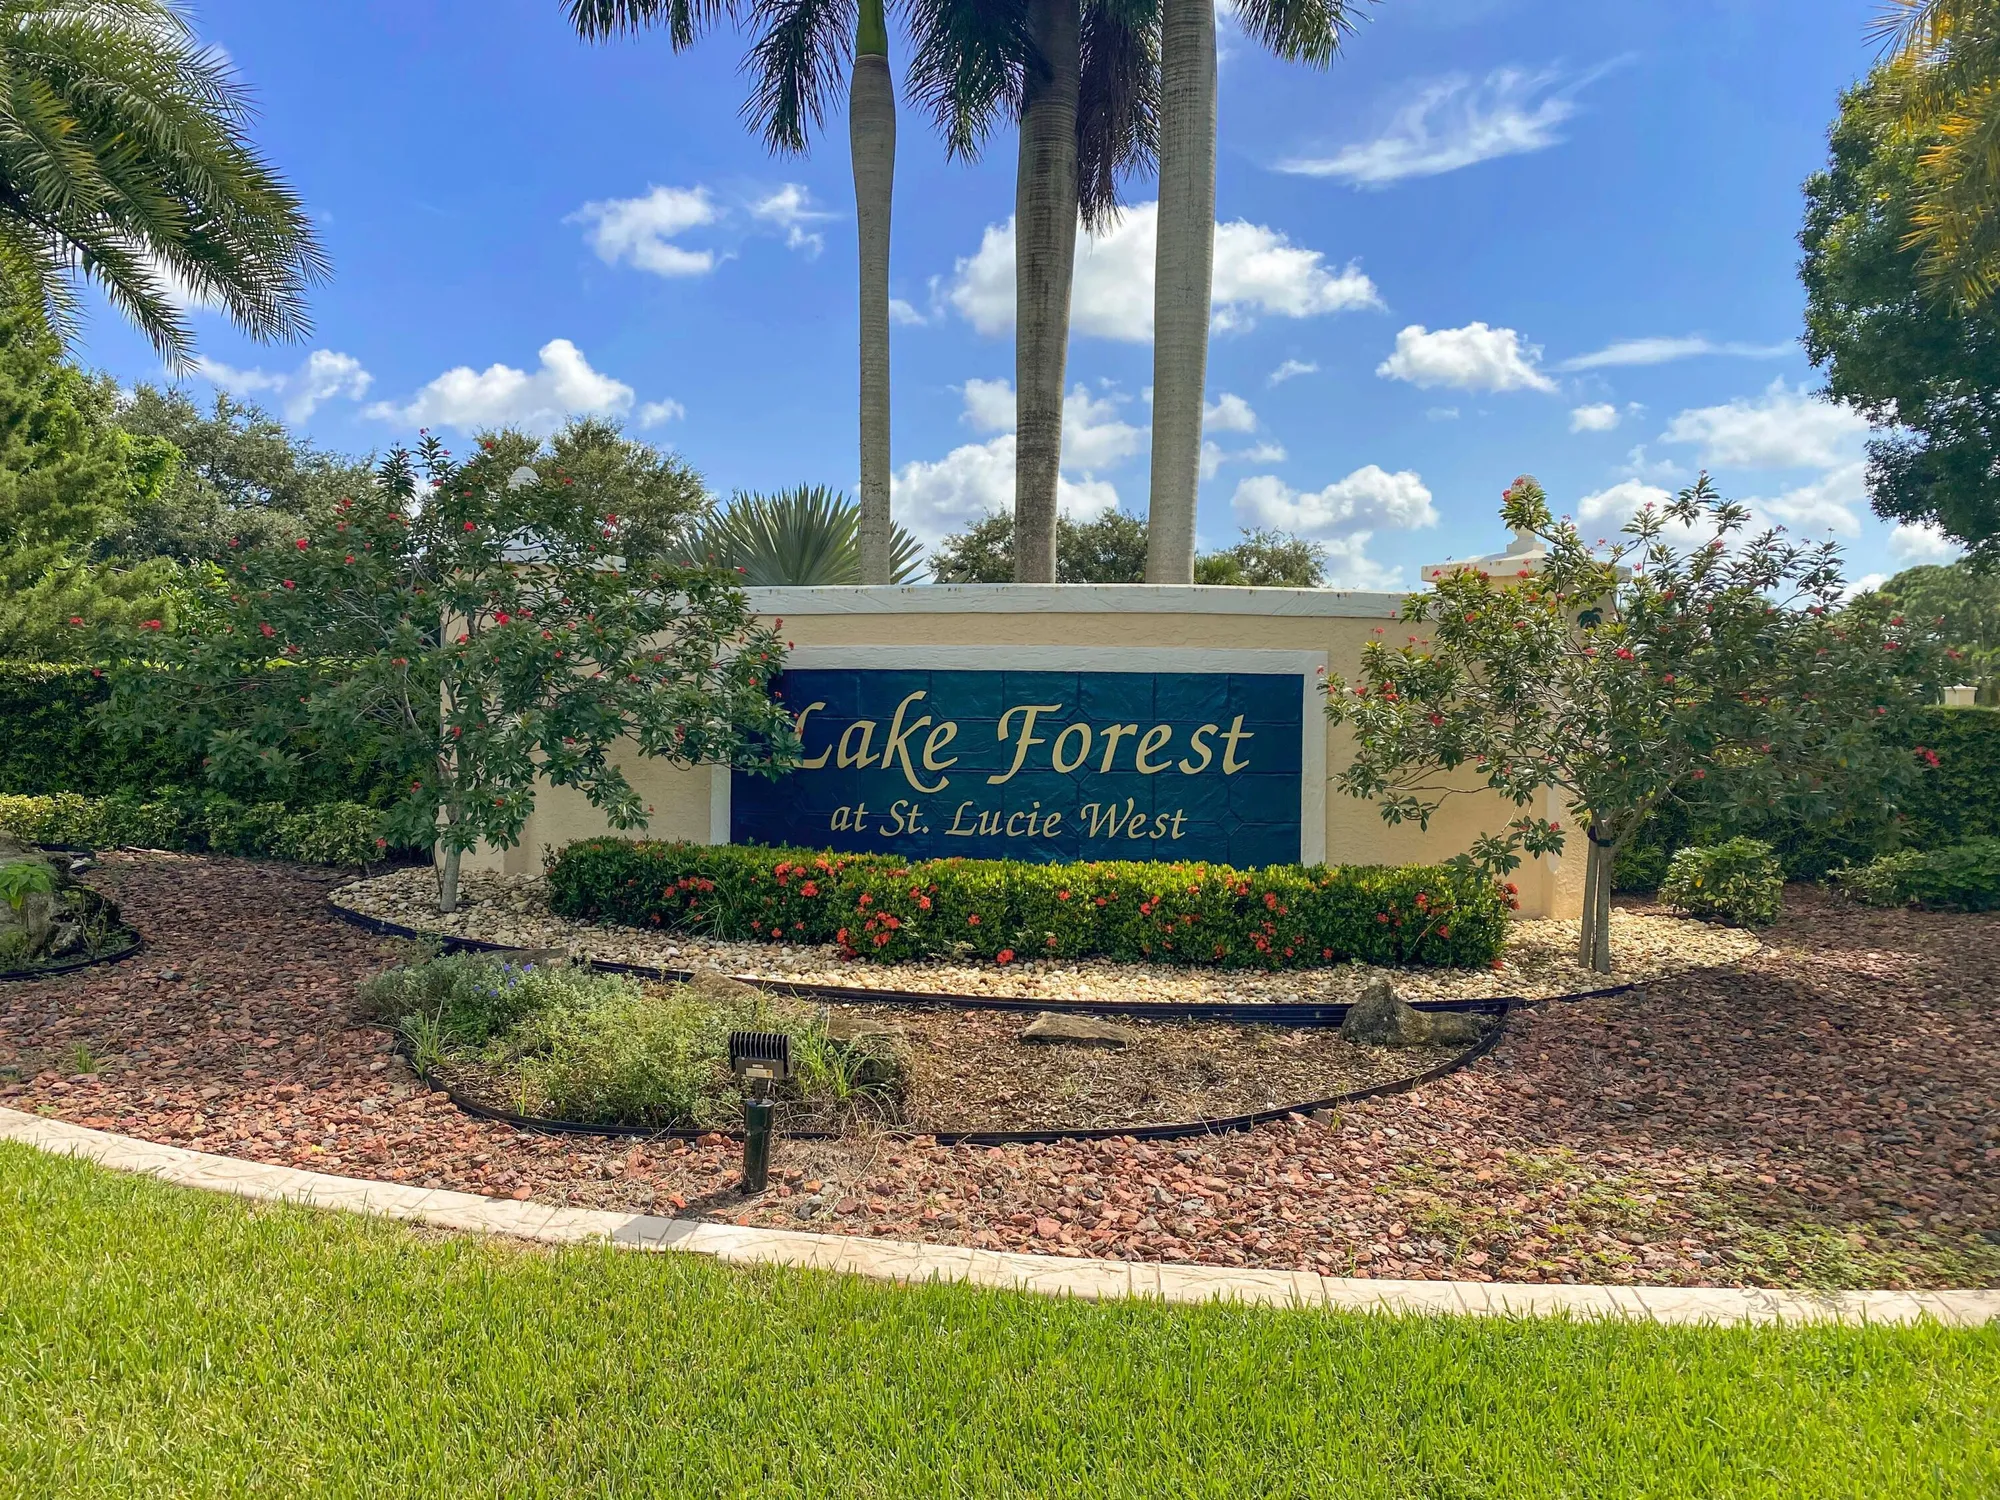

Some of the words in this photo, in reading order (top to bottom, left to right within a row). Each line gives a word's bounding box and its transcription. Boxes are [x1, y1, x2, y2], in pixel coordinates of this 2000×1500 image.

[778, 690, 958, 793] Lake
[987, 703, 1255, 785] Forest
[831, 803, 868, 832] at
[879, 799, 930, 837] St.
[945, 801, 1063, 838] Lucie
[1080, 797, 1189, 840] West
